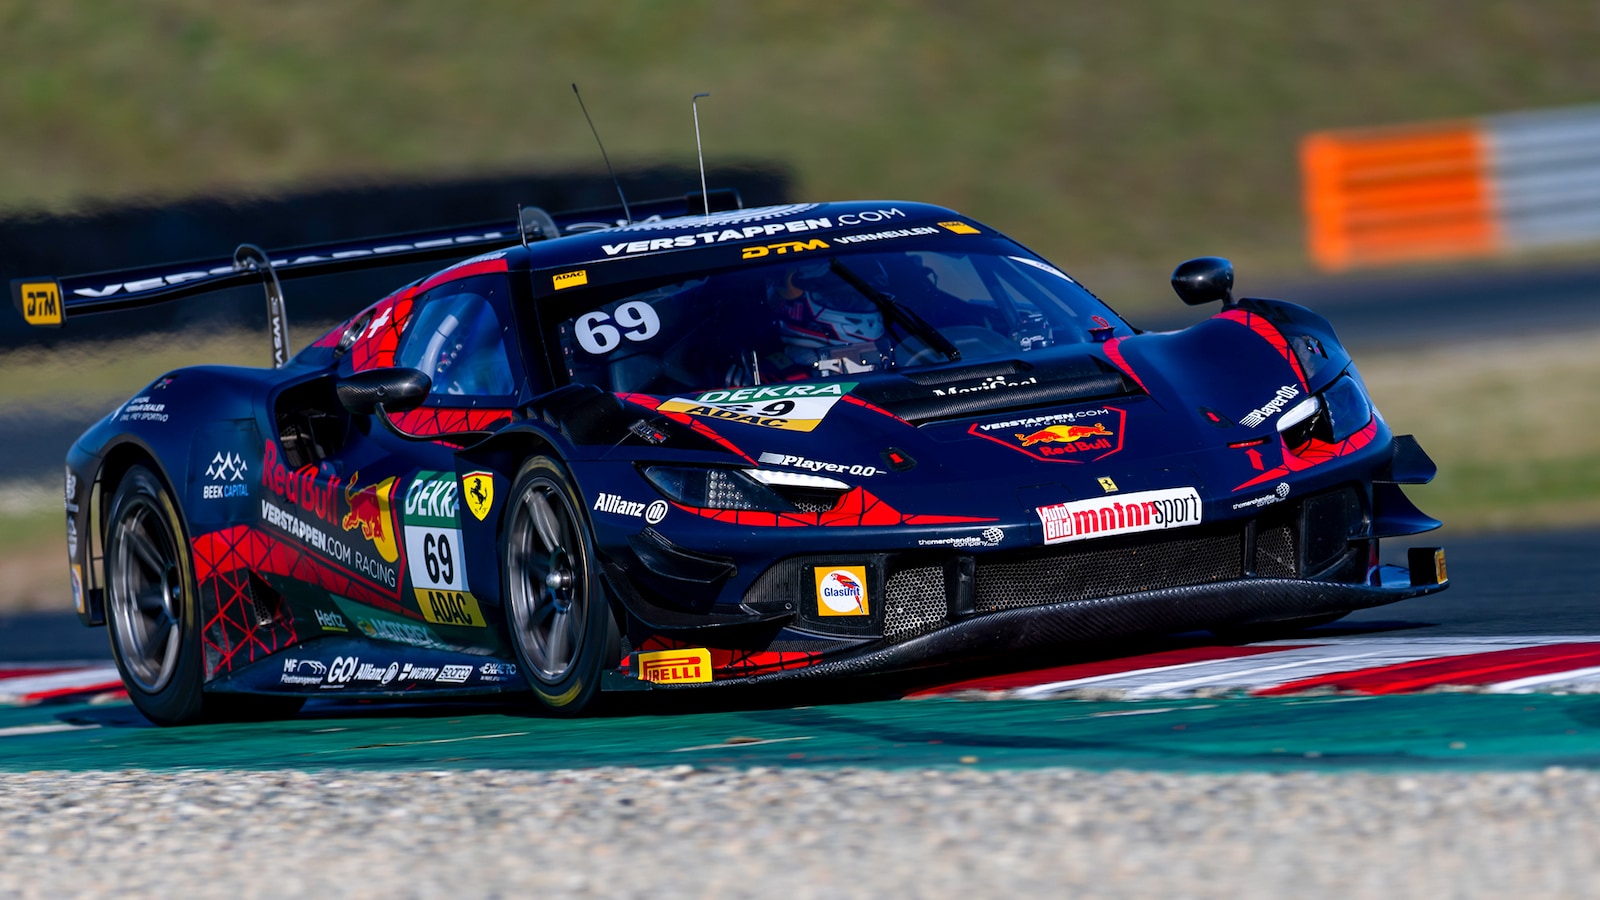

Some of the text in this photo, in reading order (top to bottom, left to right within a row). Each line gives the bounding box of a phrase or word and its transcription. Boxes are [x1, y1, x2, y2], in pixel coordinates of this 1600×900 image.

[601, 206, 905, 256] VERSTAPPEN.COM
[833, 226, 940, 246] VERMEULEN
[742, 240, 830, 260] DTM
[555, 271, 584, 281] ADAC
[27, 290, 57, 317] DTM
[574, 300, 661, 355] 69
[700, 383, 843, 403] DEKRA
[686, 405, 789, 428] ADAC
[980, 409, 1109, 431] VERSTAPPEN.COM
[1025, 418, 1076, 428] RACING
[1039, 438, 1112, 456] Red Bull
[203, 483, 249, 499] BEEK CAPITAL
[262, 438, 342, 527] Red Bull
[593, 492, 646, 518] Allianz
[1043, 505, 1066, 520] Auto
[1047, 519, 1071, 539] Bild
[261, 499, 396, 588] VERSTAPPEN.COM RACING
[423, 532, 454, 585] 69
[824, 587, 860, 597] Glasurit
[314, 608, 346, 628] Hertz
[428, 590, 473, 626] ADAC
[283, 658, 298, 672] MF
[327, 656, 359, 683] GO!
[354, 663, 386, 681] Allianz
[643, 656, 701, 681] PIRELLI
